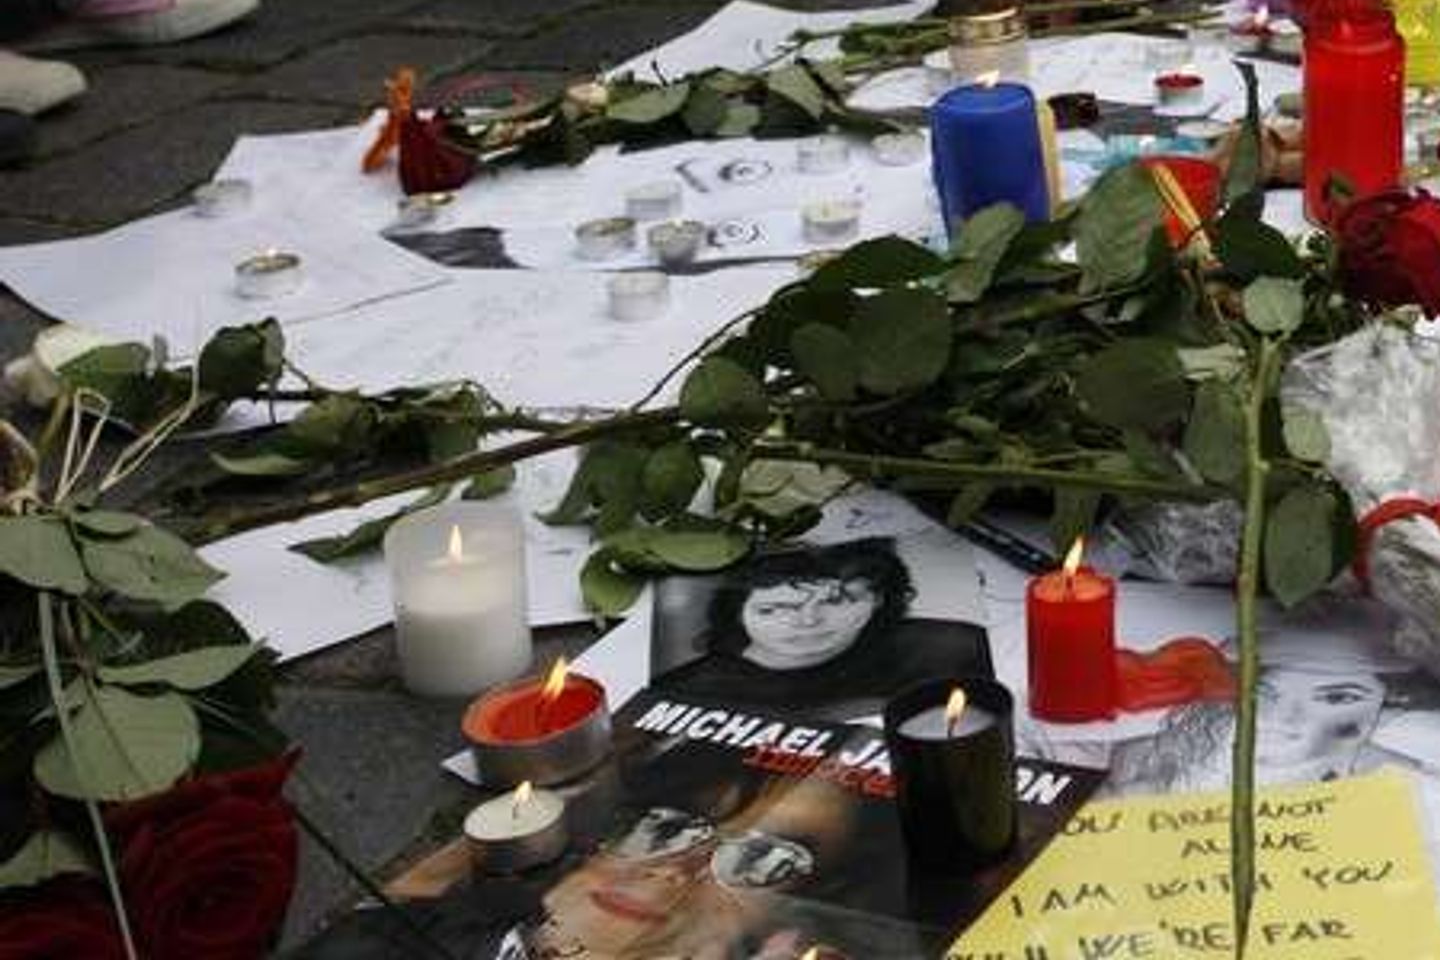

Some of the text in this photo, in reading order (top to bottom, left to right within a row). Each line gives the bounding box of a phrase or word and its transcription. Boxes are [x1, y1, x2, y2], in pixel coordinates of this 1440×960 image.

[633, 701, 834, 757] MICHAEL
[1063, 811, 1122, 836] OU
[1182, 833, 1319, 858] ALNE
[1042, 882, 1117, 912] AM
[1303, 861, 1394, 888] YOU
[1262, 920, 1353, 944] FAR
